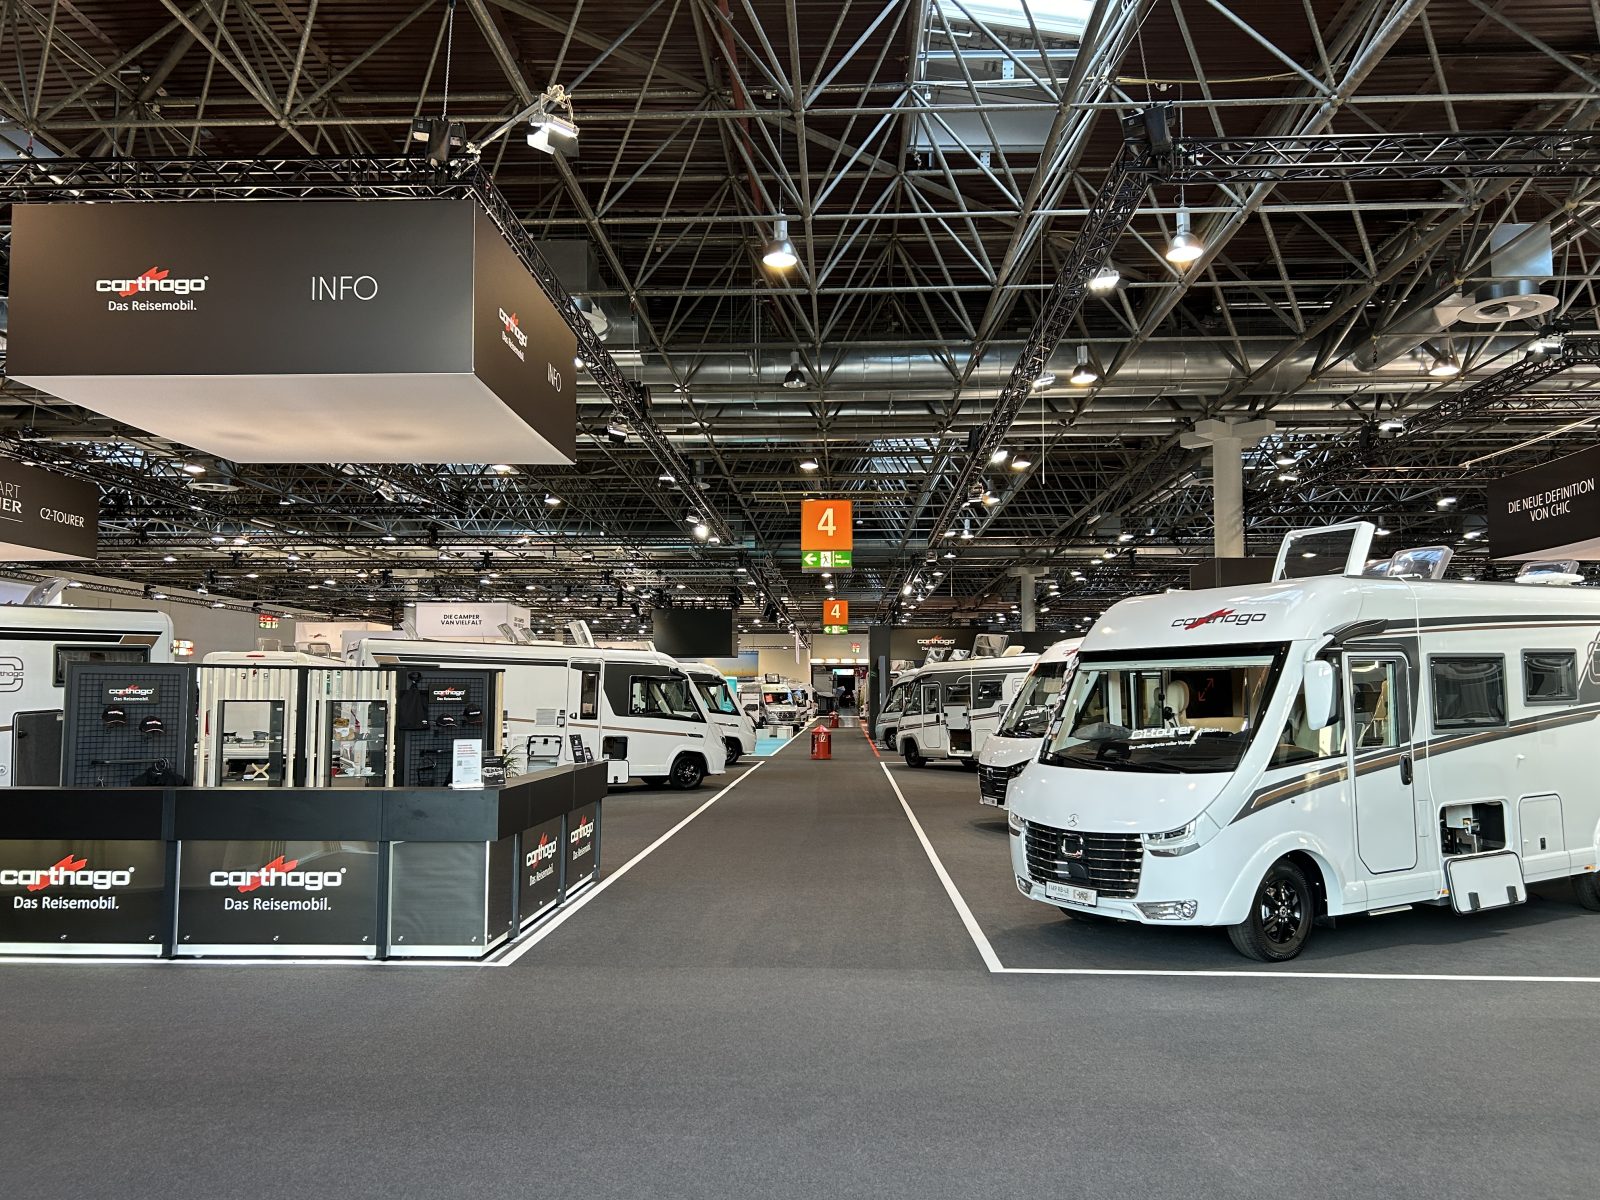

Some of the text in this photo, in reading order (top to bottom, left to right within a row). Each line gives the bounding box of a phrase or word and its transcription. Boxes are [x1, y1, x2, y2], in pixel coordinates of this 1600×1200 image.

[95, 275, 206, 295] carthago
[311, 275, 378, 301] INFO
[108, 300, 197, 311] Das Reisemobil.
[547, 361, 562, 393] INFO
[0, 497, 22, 514] ER
[1508, 477, 1595, 514] DIE NEUE DEFINITION
[39, 507, 85, 528] C2-TOURER
[1529, 500, 1571, 522] VON CHIC
[817, 507, 837, 537] 4
[830, 603, 841, 619] 4
[108, 687, 153, 696] carthago
[0, 866, 131, 890] carthago
[210, 867, 342, 891] carthago
[13, 896, 120, 910] Das Reisemobil.
[224, 897, 332, 911] Das Reisemobil.
